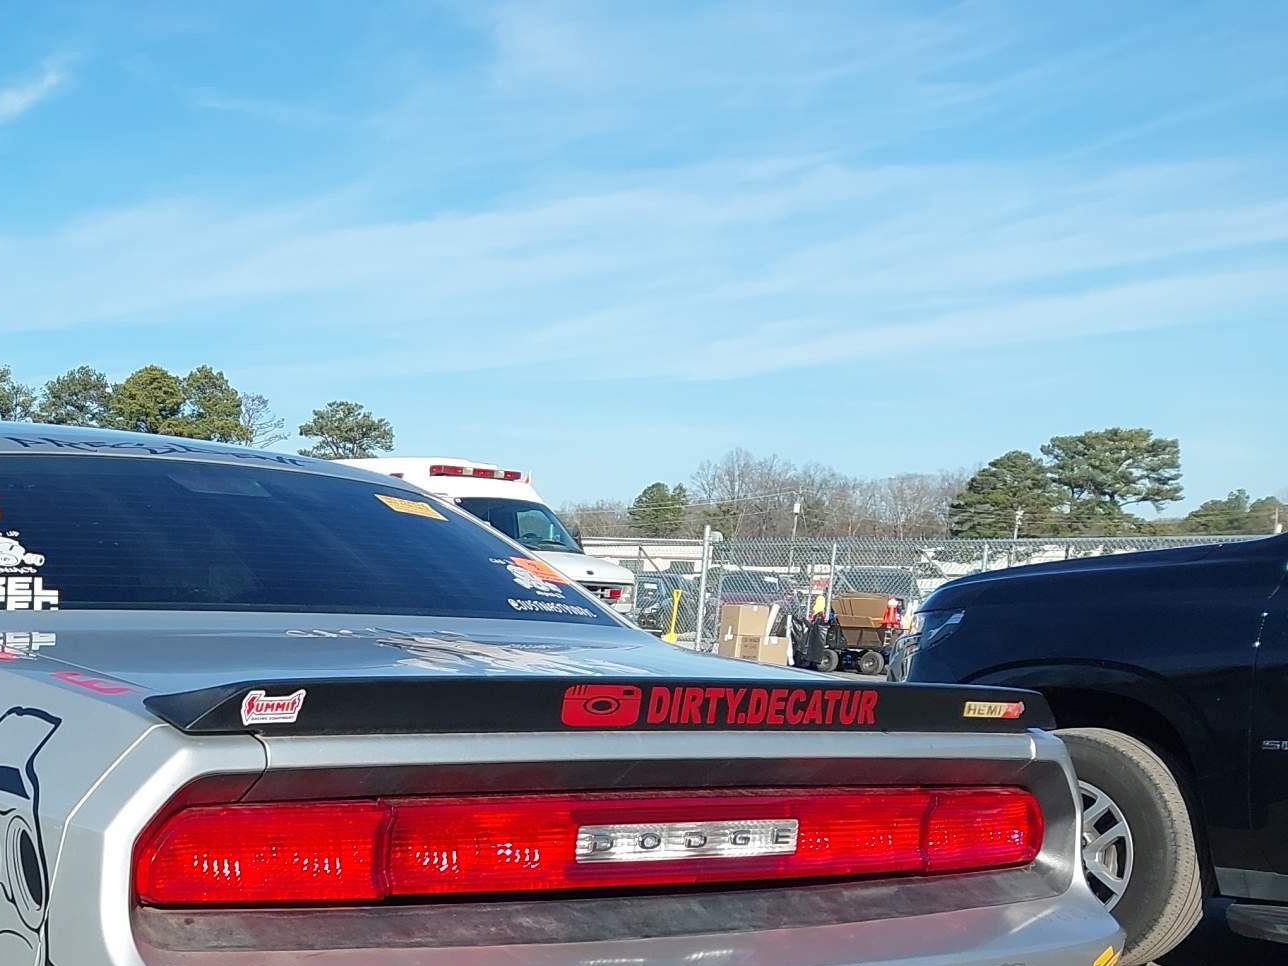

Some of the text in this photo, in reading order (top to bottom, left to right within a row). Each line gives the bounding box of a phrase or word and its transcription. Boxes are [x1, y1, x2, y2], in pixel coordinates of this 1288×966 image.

[646, 686, 879, 725] DIRTY.DECATUR
[966, 703, 1003, 717] HEMI
[591, 828, 793, 852] DODGE
